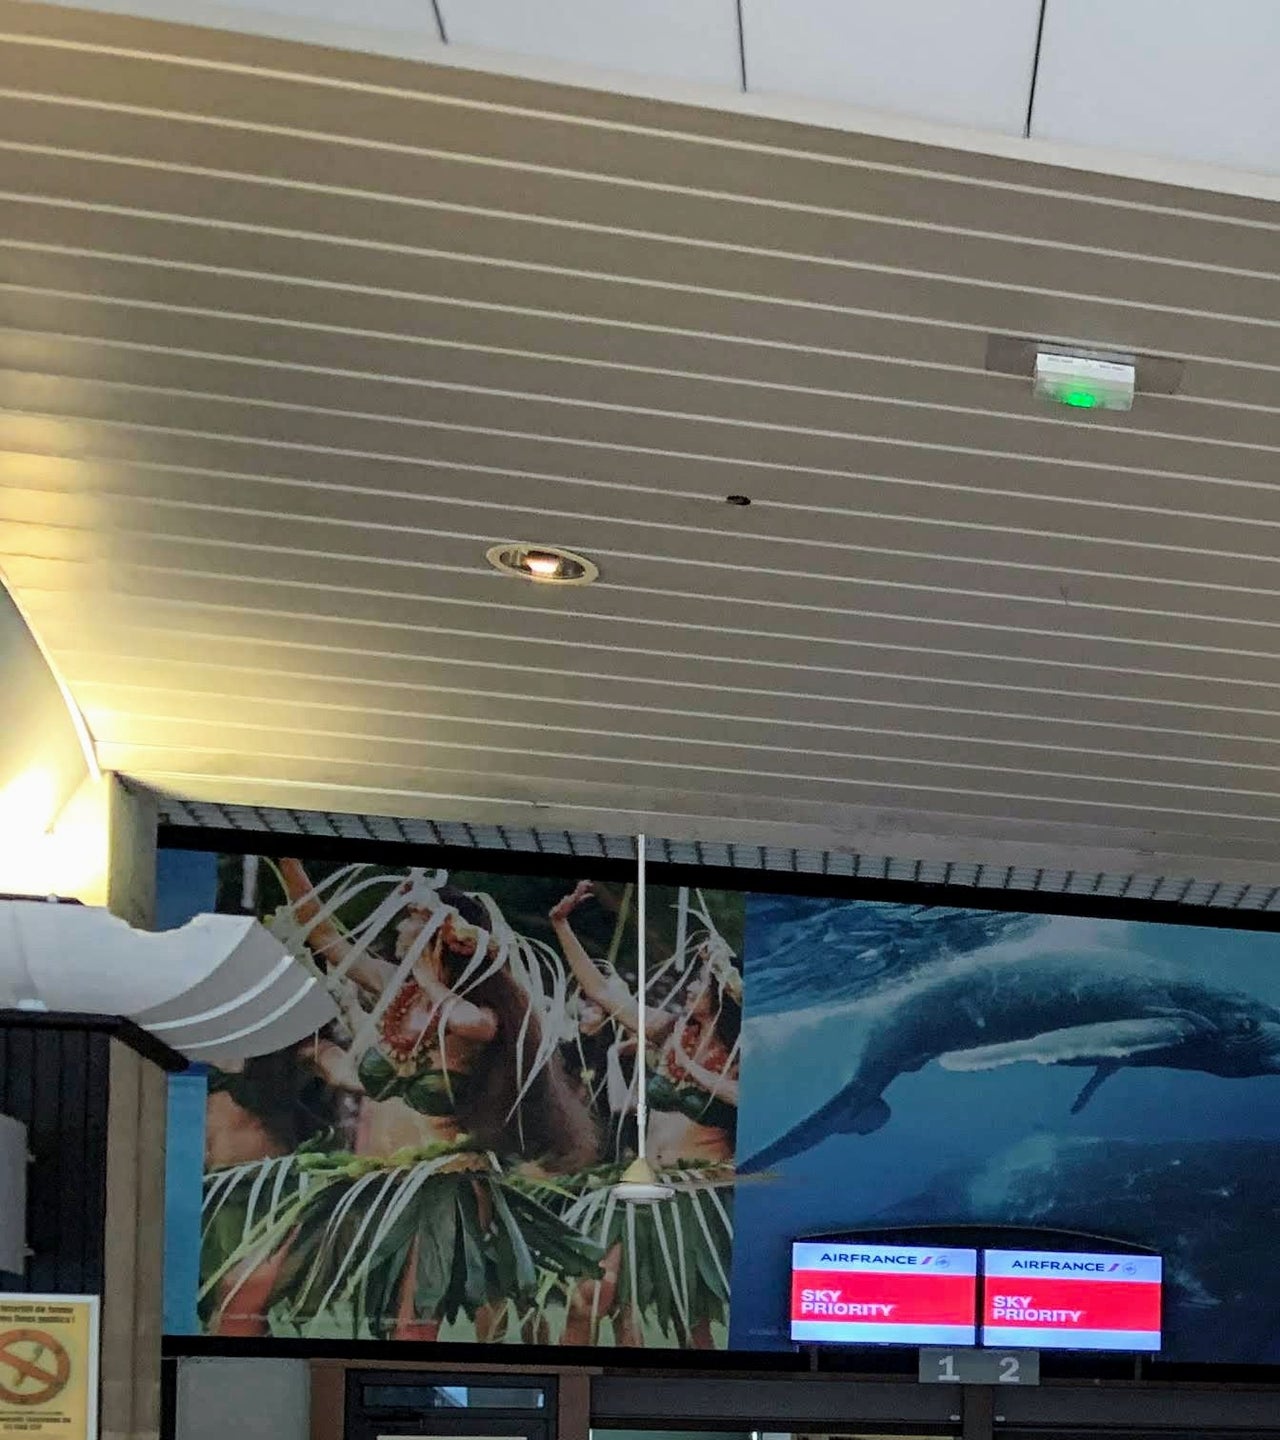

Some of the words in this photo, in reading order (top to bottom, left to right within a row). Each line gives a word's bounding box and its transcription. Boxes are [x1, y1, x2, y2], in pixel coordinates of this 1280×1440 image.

[820, 1253, 917, 1265] AIRFRANCE
[1012, 1260, 1105, 1272] AIRFRANCE
[801, 1288, 842, 1303] SKY
[992, 1295, 1032, 1309] SKY
[801, 1302, 894, 1317] PRIORITY
[992, 1308, 1082, 1323] PRIORITY
[938, 1355, 960, 1381] 1
[999, 1356, 1020, 1382] 2
